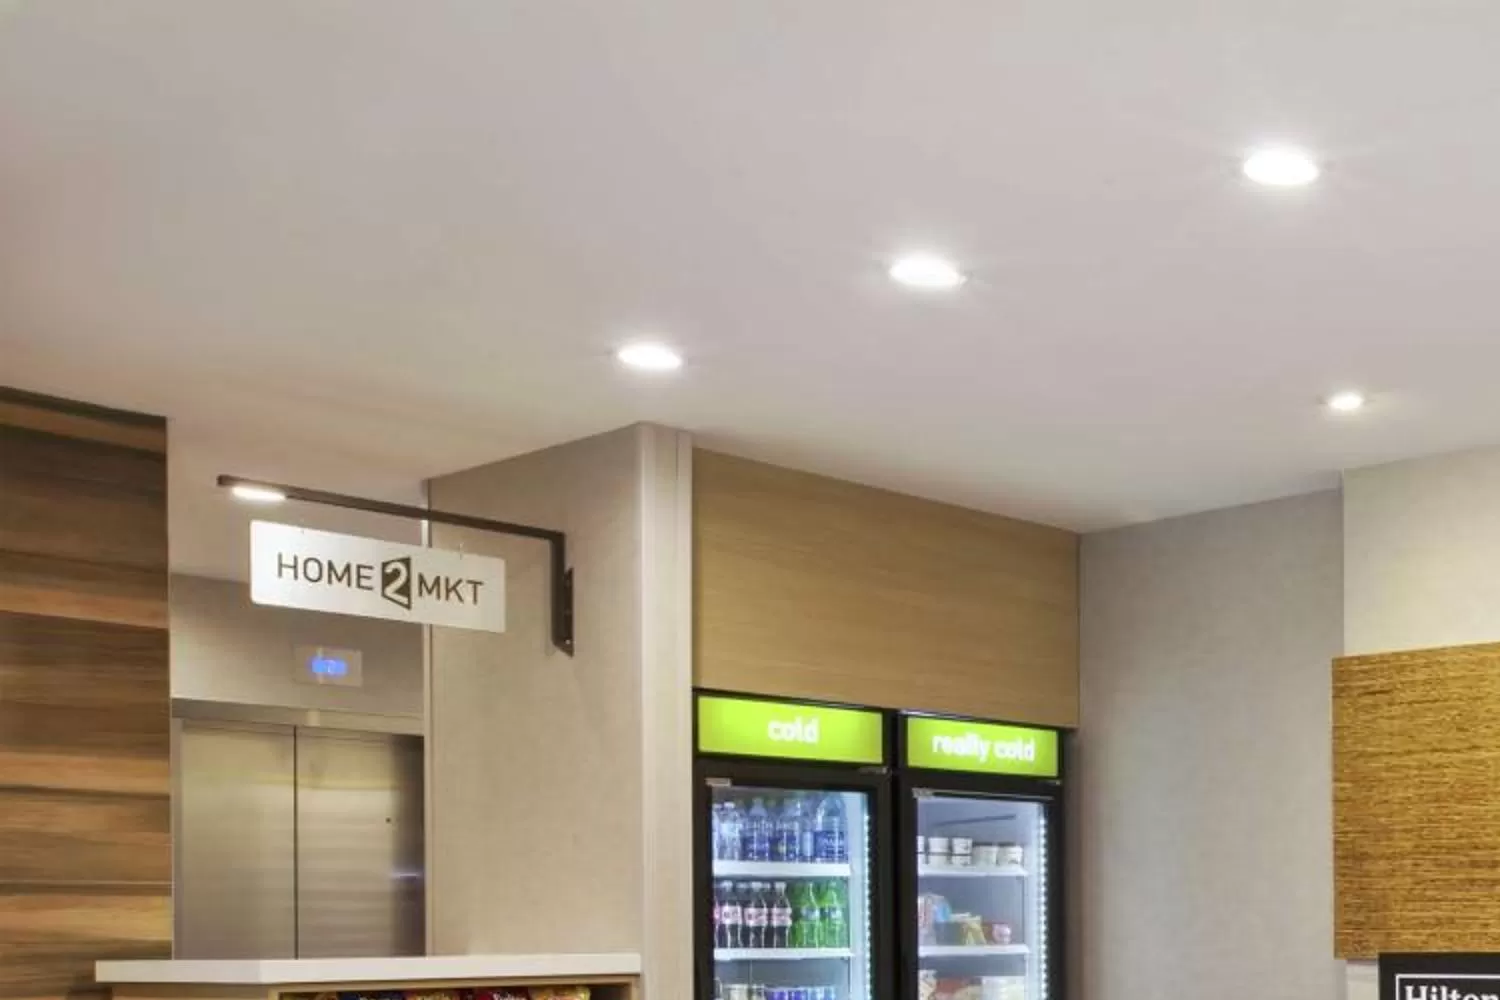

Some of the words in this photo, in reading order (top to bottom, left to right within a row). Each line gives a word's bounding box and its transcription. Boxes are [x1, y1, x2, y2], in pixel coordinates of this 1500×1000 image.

[767, 717, 819, 744] cold
[931, 731, 990, 762] really
[994, 736, 1035, 761] cold
